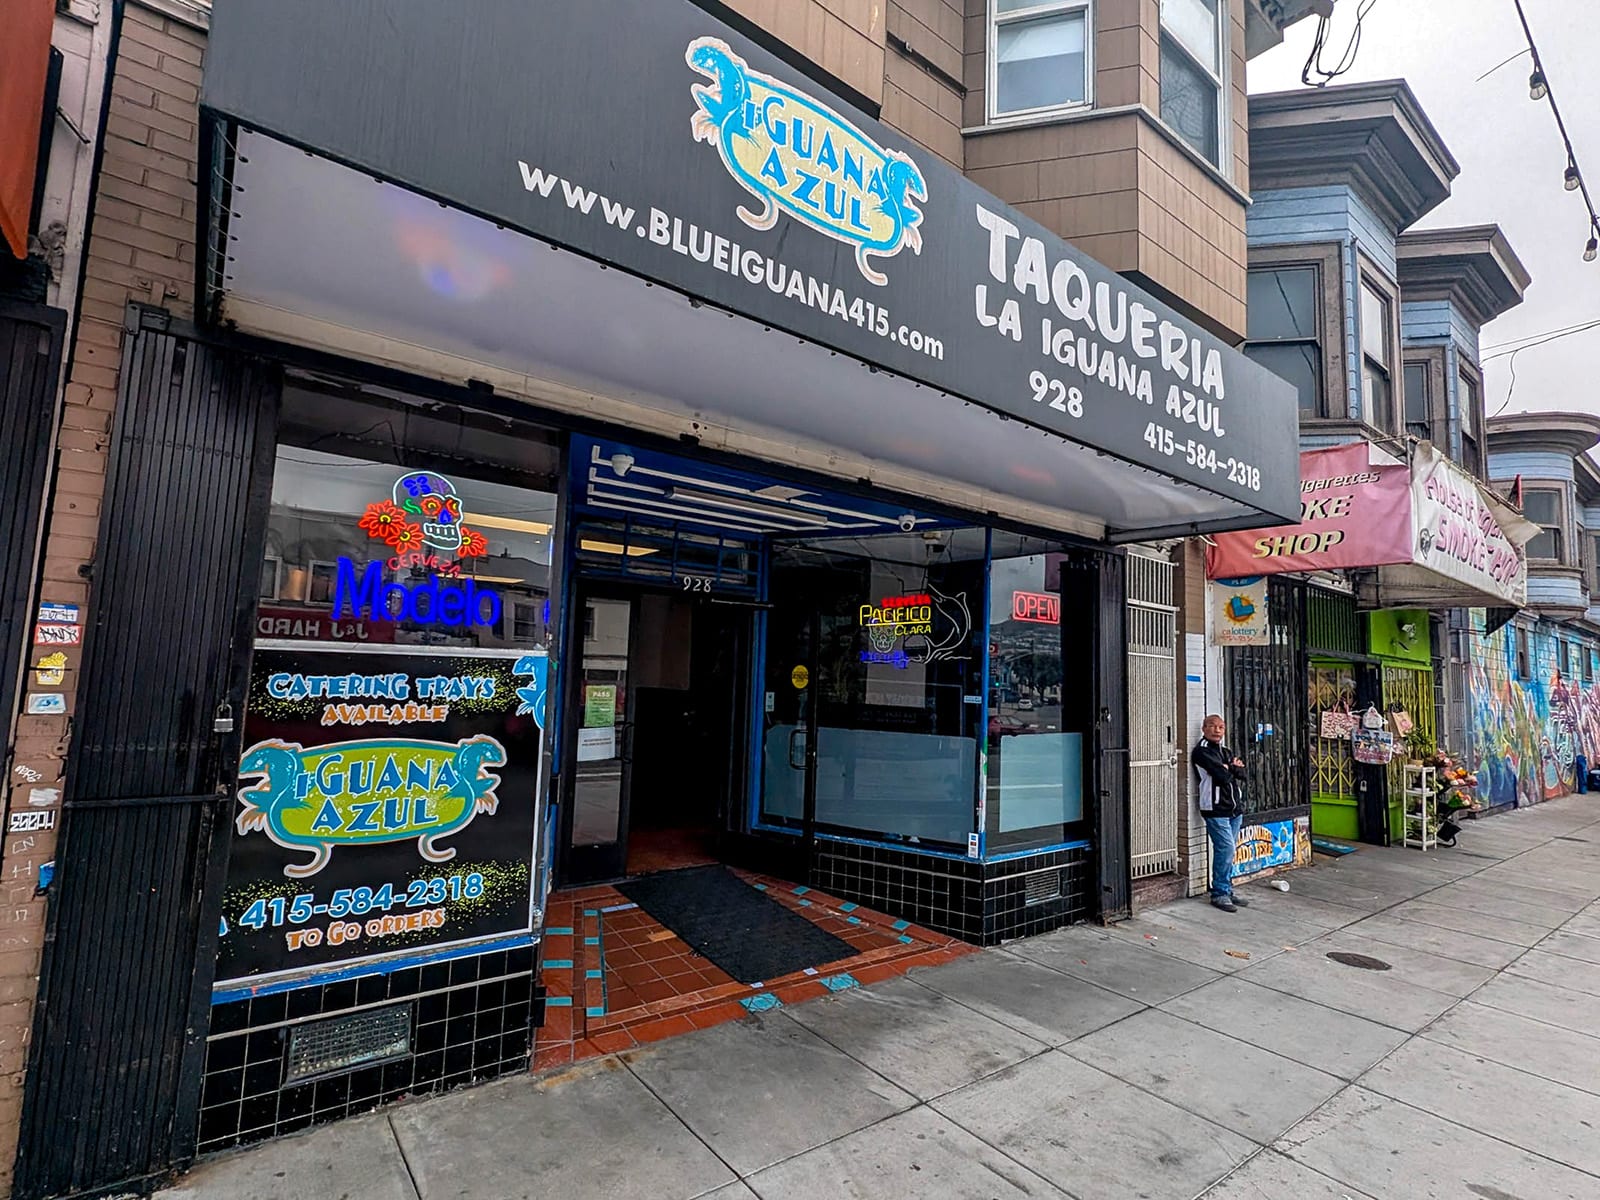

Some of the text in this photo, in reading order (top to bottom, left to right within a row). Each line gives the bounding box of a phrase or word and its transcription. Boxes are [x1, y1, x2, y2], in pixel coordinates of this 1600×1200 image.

[743, 96, 890, 202] IGUANA
[761, 150, 872, 232] AZUL
[518, 161, 944, 360] www.BLUEIGUANA415.com
[976, 203, 1225, 400] TAQUERIA
[975, 284, 1225, 438] LA IGUANA AZUL
[1029, 370, 1084, 418] 928
[1143, 422, 1261, 491] 415-584-2318
[1300, 471, 1381, 493] igarettes
[1300, 495, 1354, 521] KE
[387, 553, 461, 578] CERVEZA
[1252, 529, 1345, 560] SHOP
[1435, 517, 1485, 572] SMOKE
[331, 556, 500, 627] Modelo
[683, 575, 712, 593] 928
[859, 604, 932, 627] PACIFICO
[894, 624, 932, 636] CLARA
[1014, 594, 1059, 622] OPEN
[267, 672, 495, 701] CATERING TRAYS
[320, 701, 449, 726] AVAILABLE
[294, 753, 462, 800] IGUANA
[310, 797, 438, 835] AZUL
[239, 873, 484, 930] 415-584-2318
[285, 926, 323, 952] TO
[365, 907, 445, 939] ORDERS
